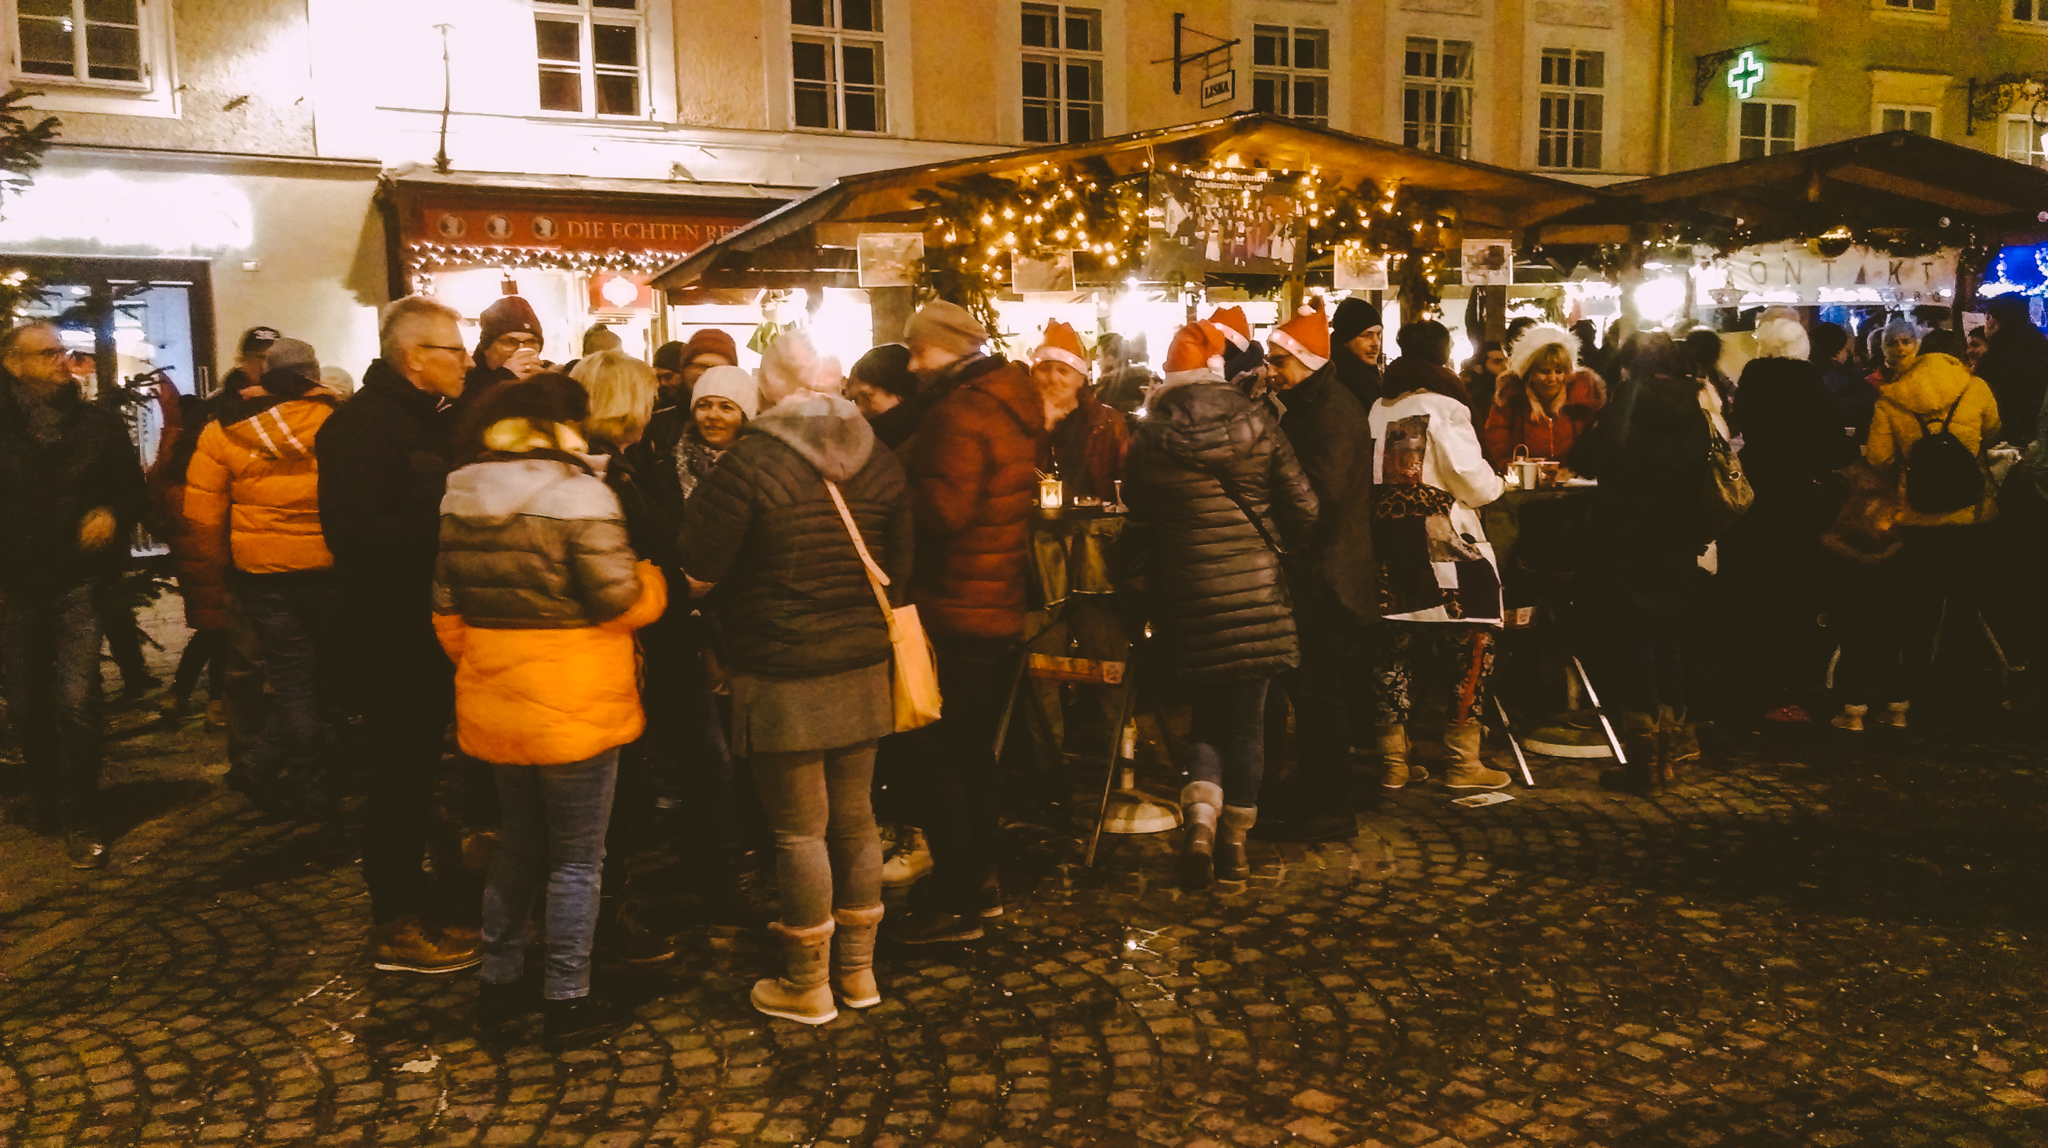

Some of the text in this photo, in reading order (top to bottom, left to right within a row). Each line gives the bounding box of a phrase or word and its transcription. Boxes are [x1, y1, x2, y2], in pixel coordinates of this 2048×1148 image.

[1205, 80, 1229, 99] LISKA
[567, 221, 604, 238] DIE
[611, 222, 699, 240] ECHTEN
